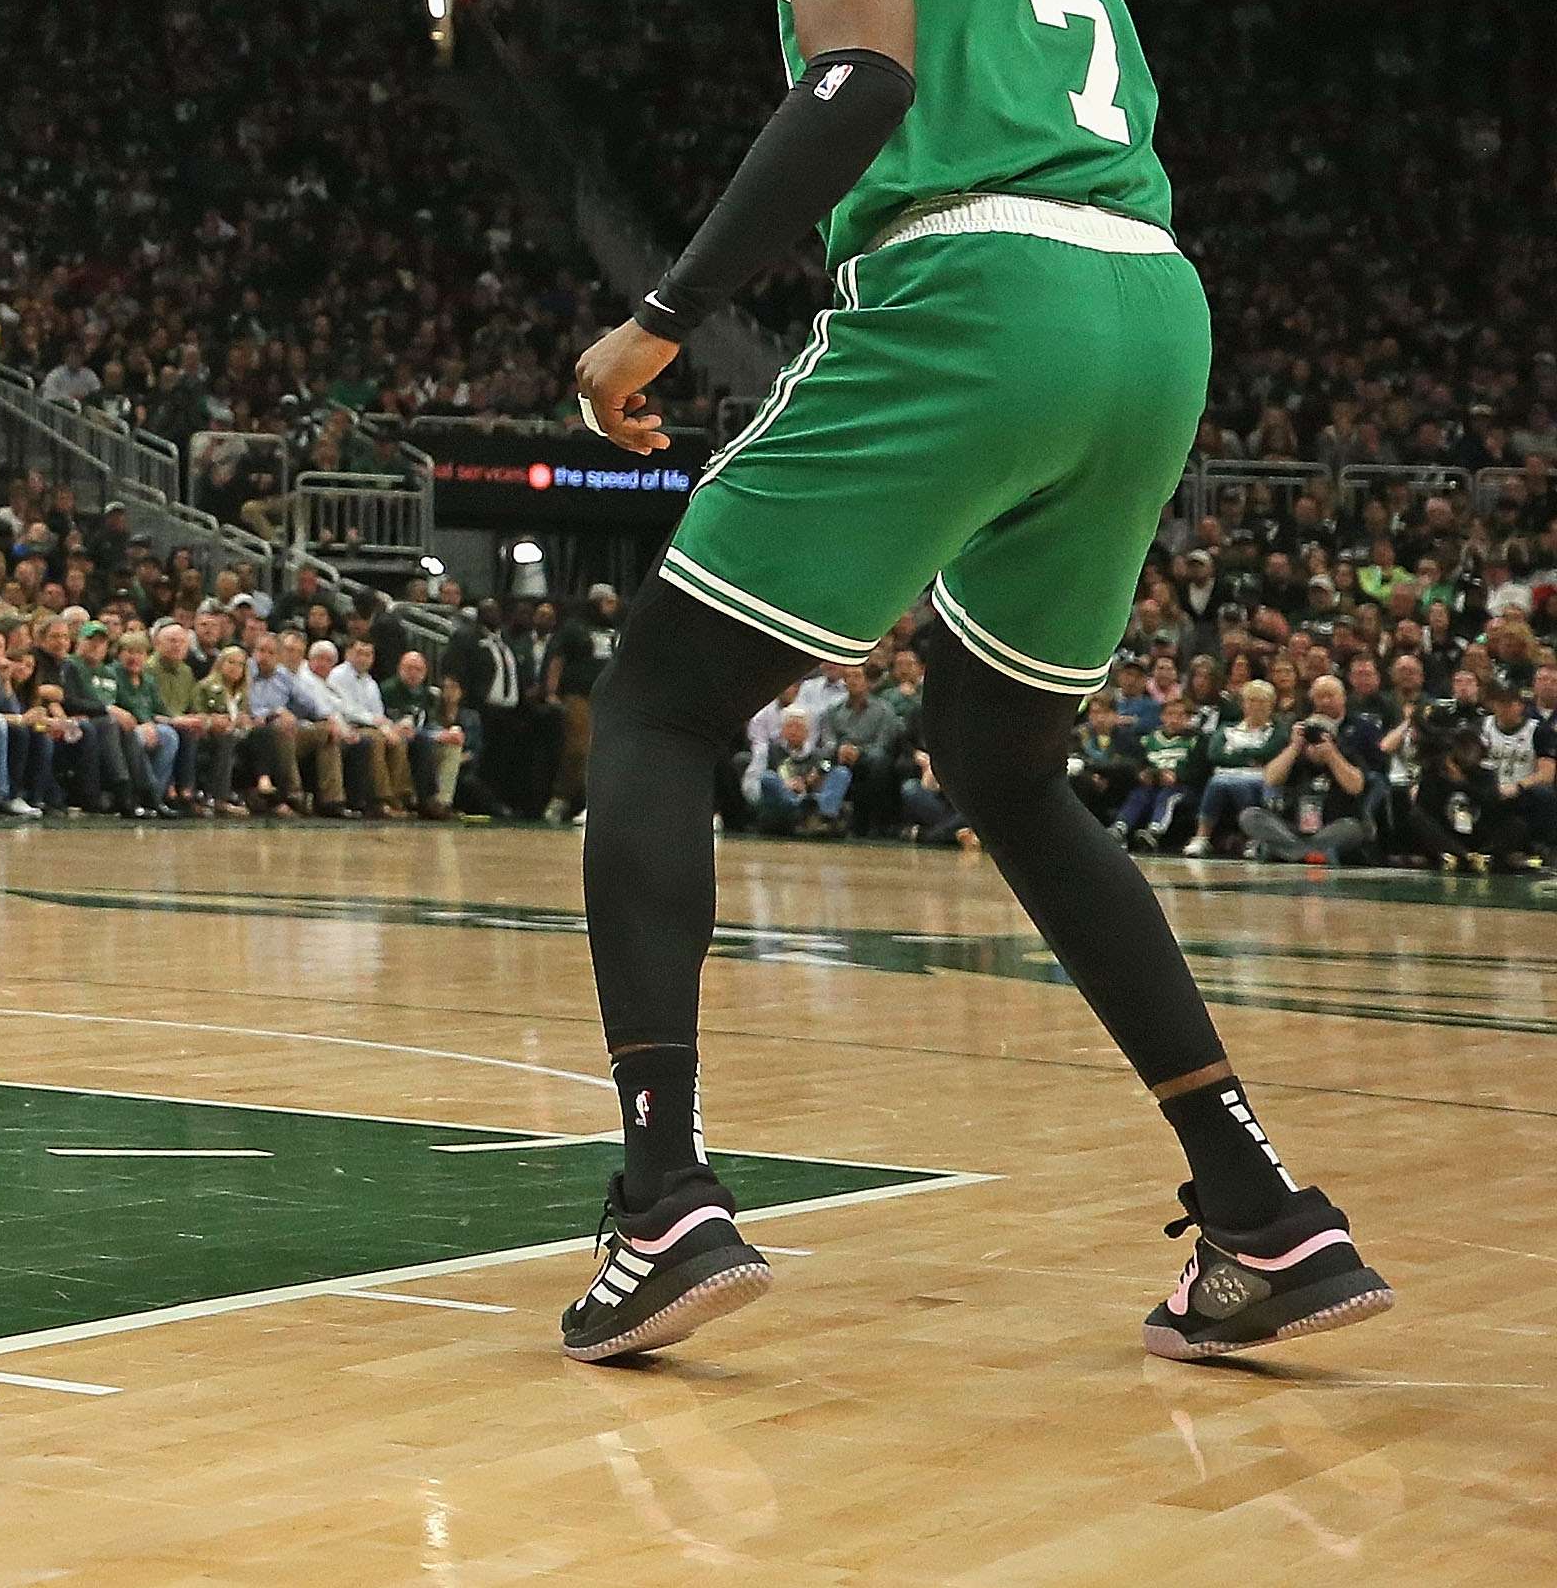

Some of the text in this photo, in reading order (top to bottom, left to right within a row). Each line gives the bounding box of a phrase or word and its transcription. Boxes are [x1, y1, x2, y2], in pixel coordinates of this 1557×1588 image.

[553, 465, 584, 486] the
[585, 468, 640, 491] speed
[640, 468, 662, 491] of
